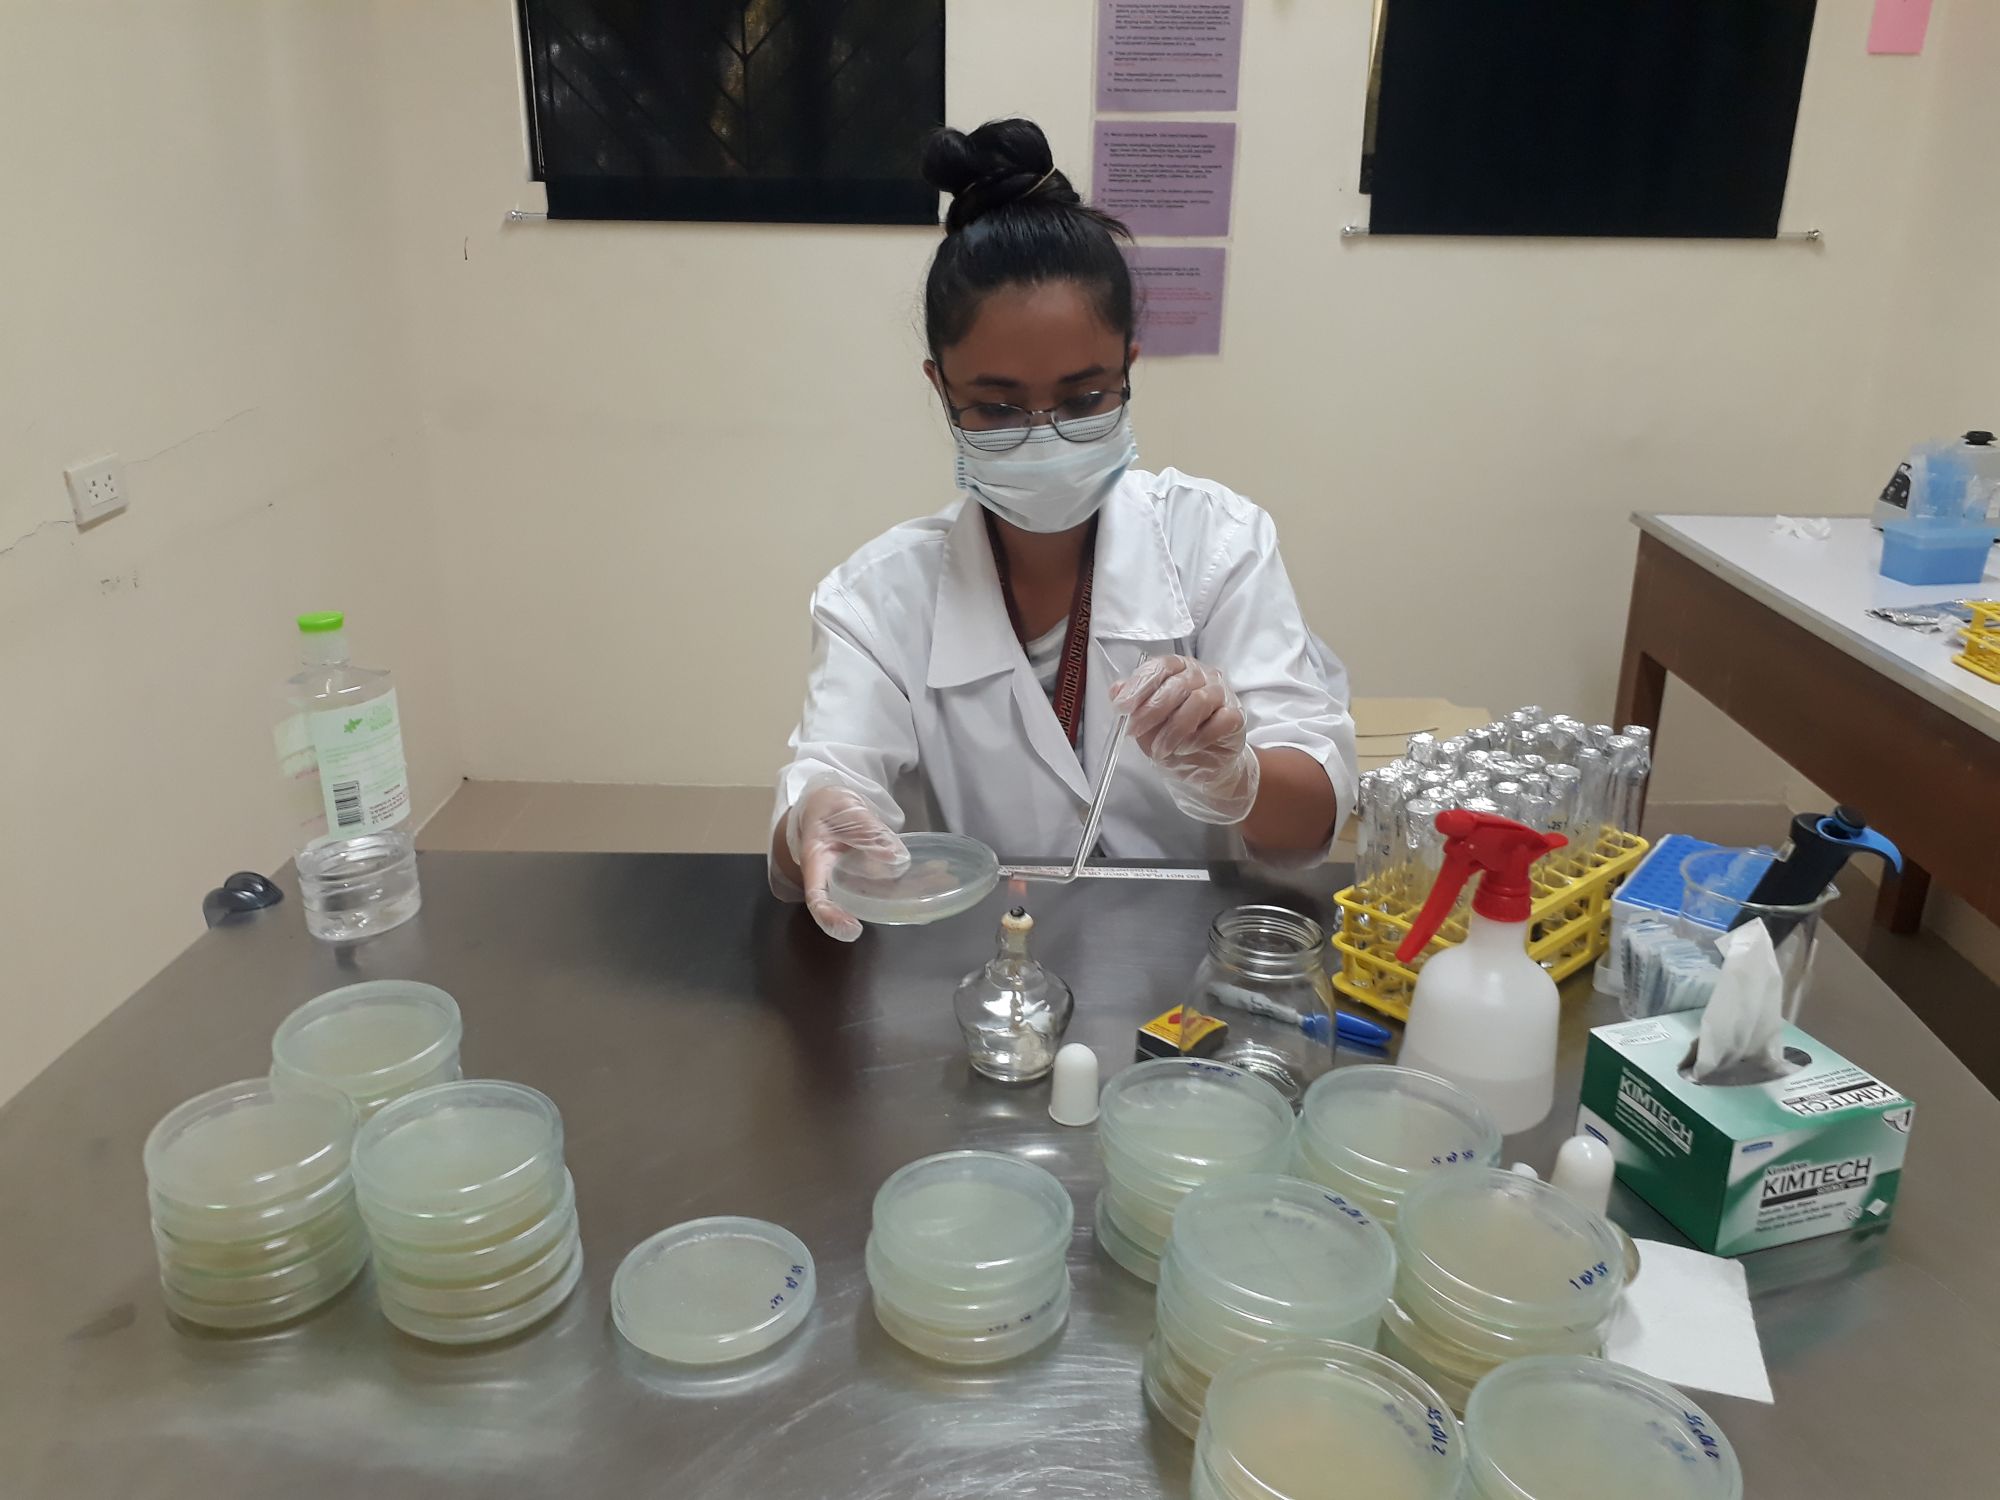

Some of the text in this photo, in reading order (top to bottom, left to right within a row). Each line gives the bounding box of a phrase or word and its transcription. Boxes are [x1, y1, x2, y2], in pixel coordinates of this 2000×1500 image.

[1060, 663, 1083, 738] PHILIPPIN
[1619, 1074, 1694, 1146] KIMTECH
[1791, 1085, 1893, 1115] KIMTECH
[1762, 1158, 1872, 1197] KIMTECH
